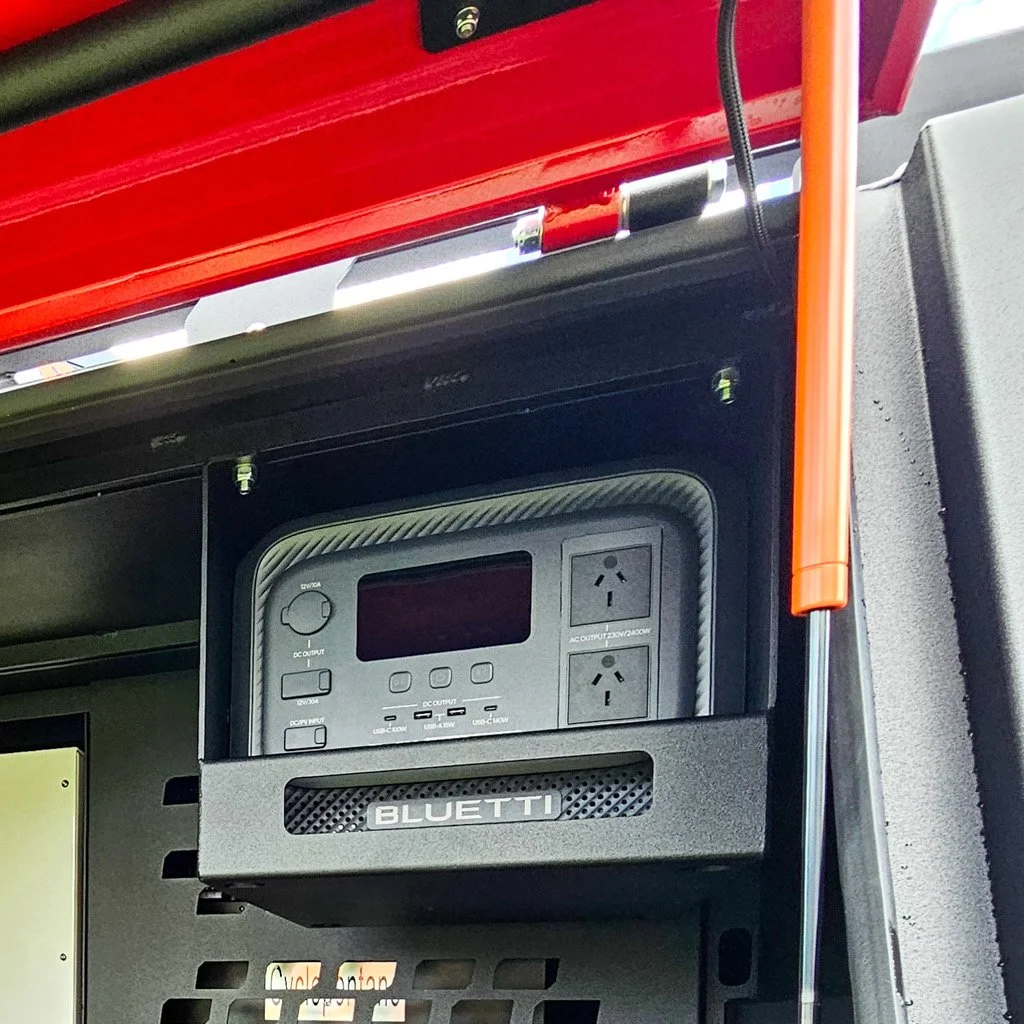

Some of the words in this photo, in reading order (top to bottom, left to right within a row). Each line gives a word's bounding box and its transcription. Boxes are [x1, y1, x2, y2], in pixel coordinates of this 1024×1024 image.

[580, 632, 606, 641] OUTPUT
[303, 649, 325, 657] OUTPUT
[375, 794, 553, 825] BLUETTI
